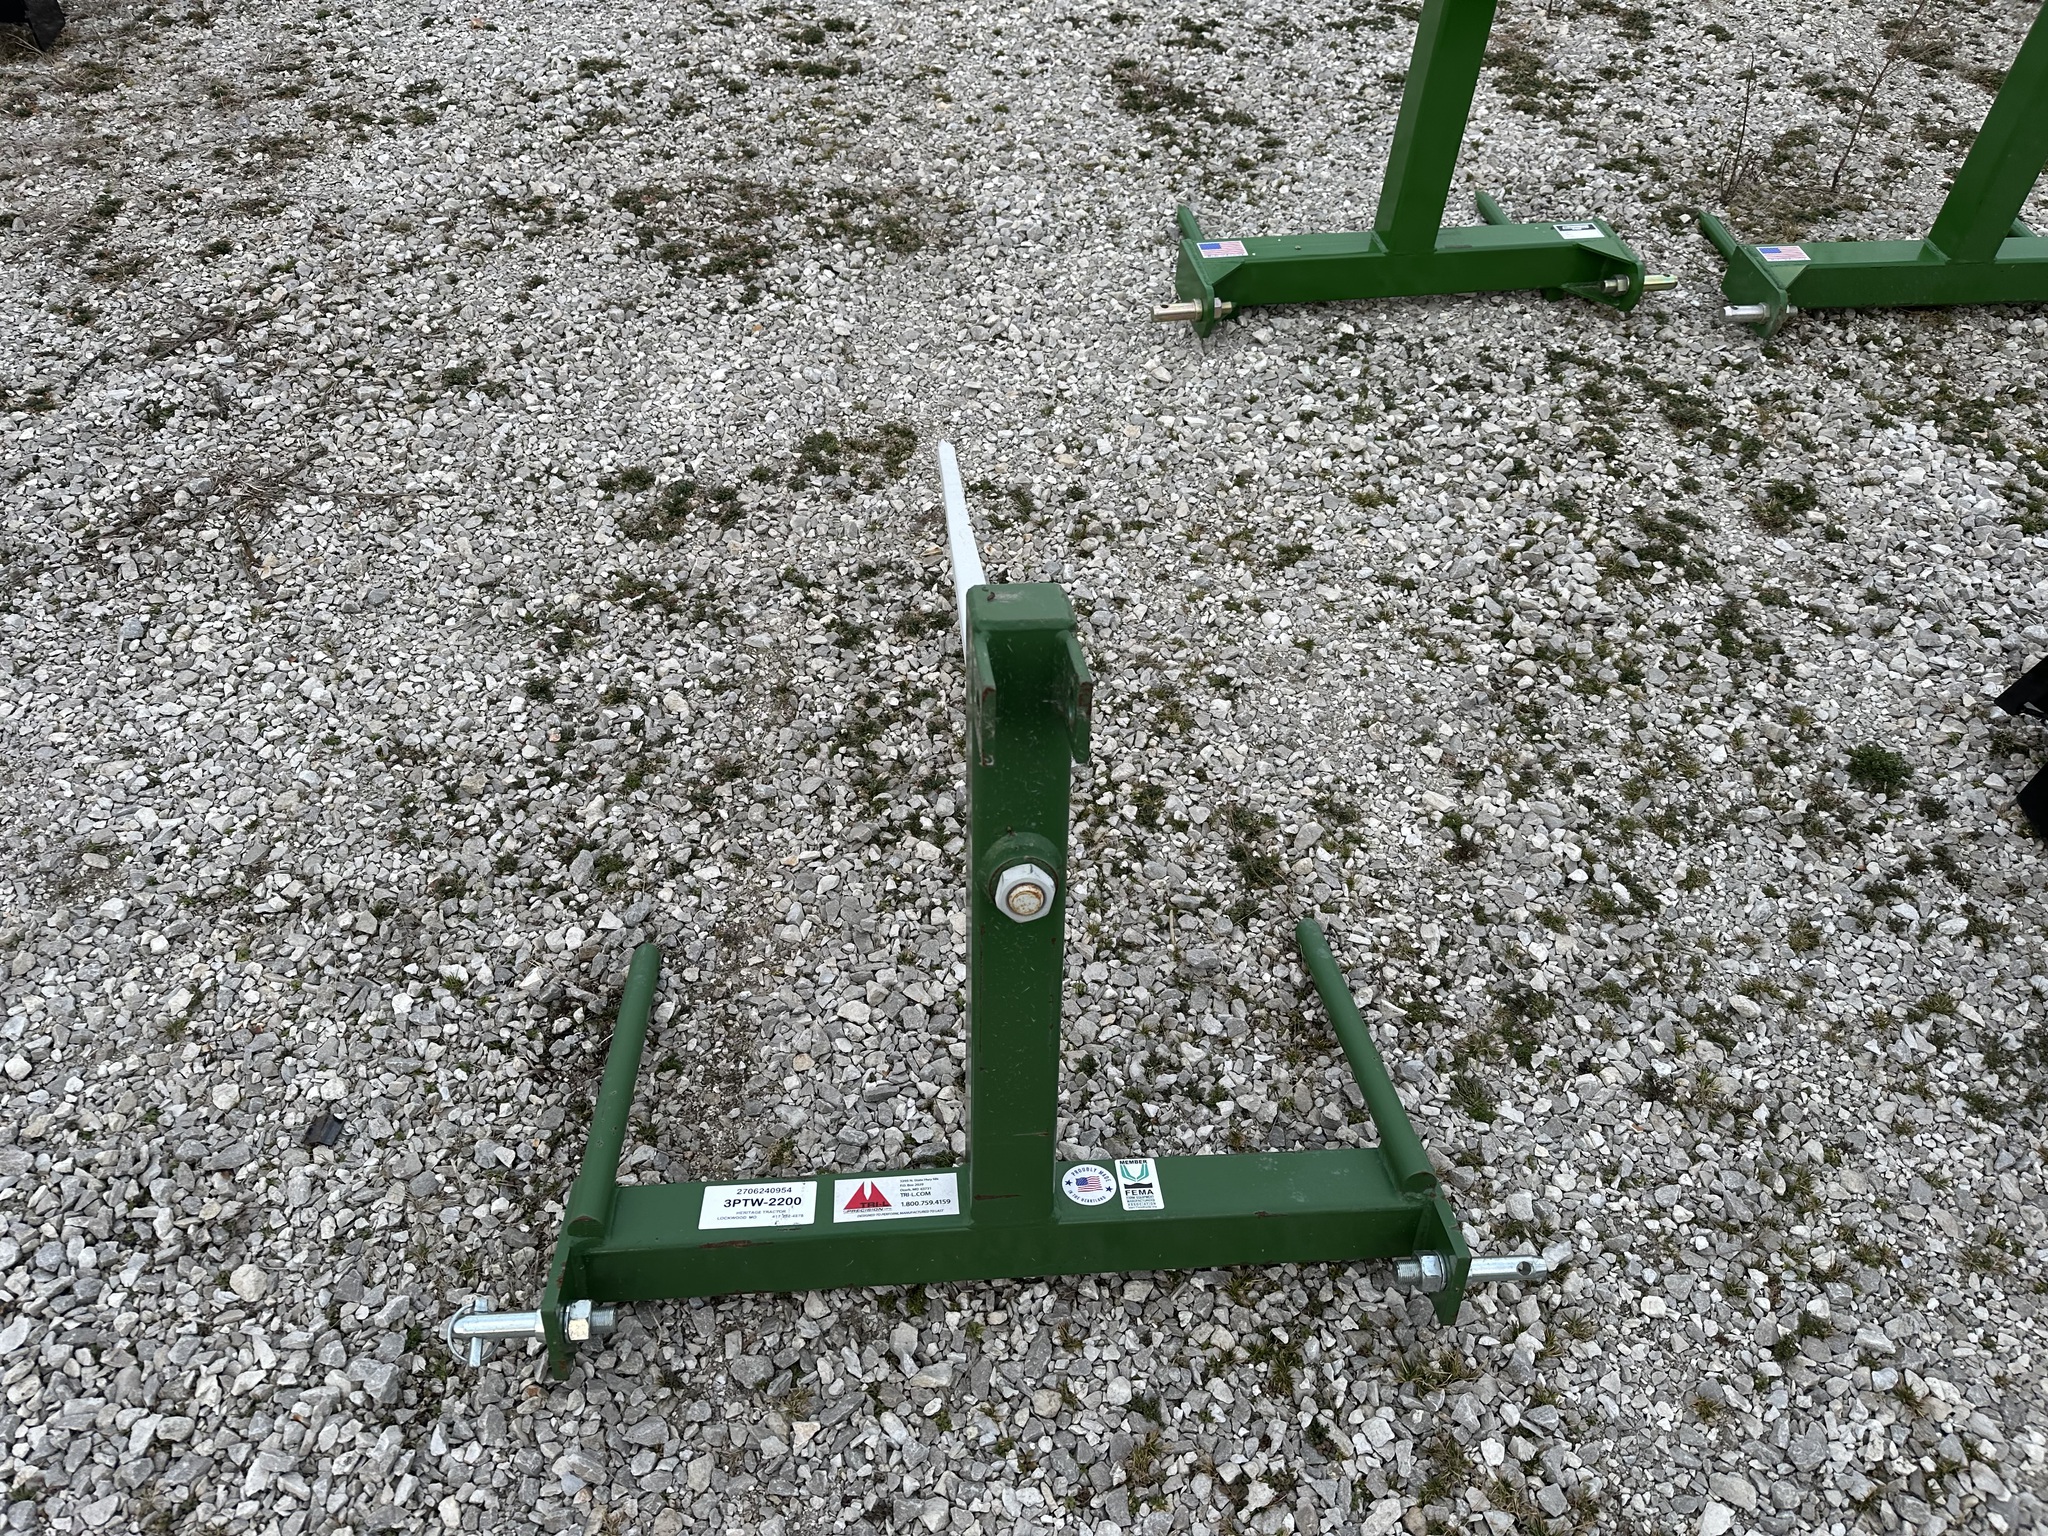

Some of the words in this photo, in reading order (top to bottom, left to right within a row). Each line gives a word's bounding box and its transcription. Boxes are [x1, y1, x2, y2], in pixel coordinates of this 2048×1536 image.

[1071, 1166, 1097, 1177] PROUDLY
[1098, 1170, 1112, 1183] MADE
[736, 1187, 792, 1195] 2706240954
[723, 1197, 802, 1208] 3PTW-2200
[901, 1198, 951, 1207] 1.800.759.4159
